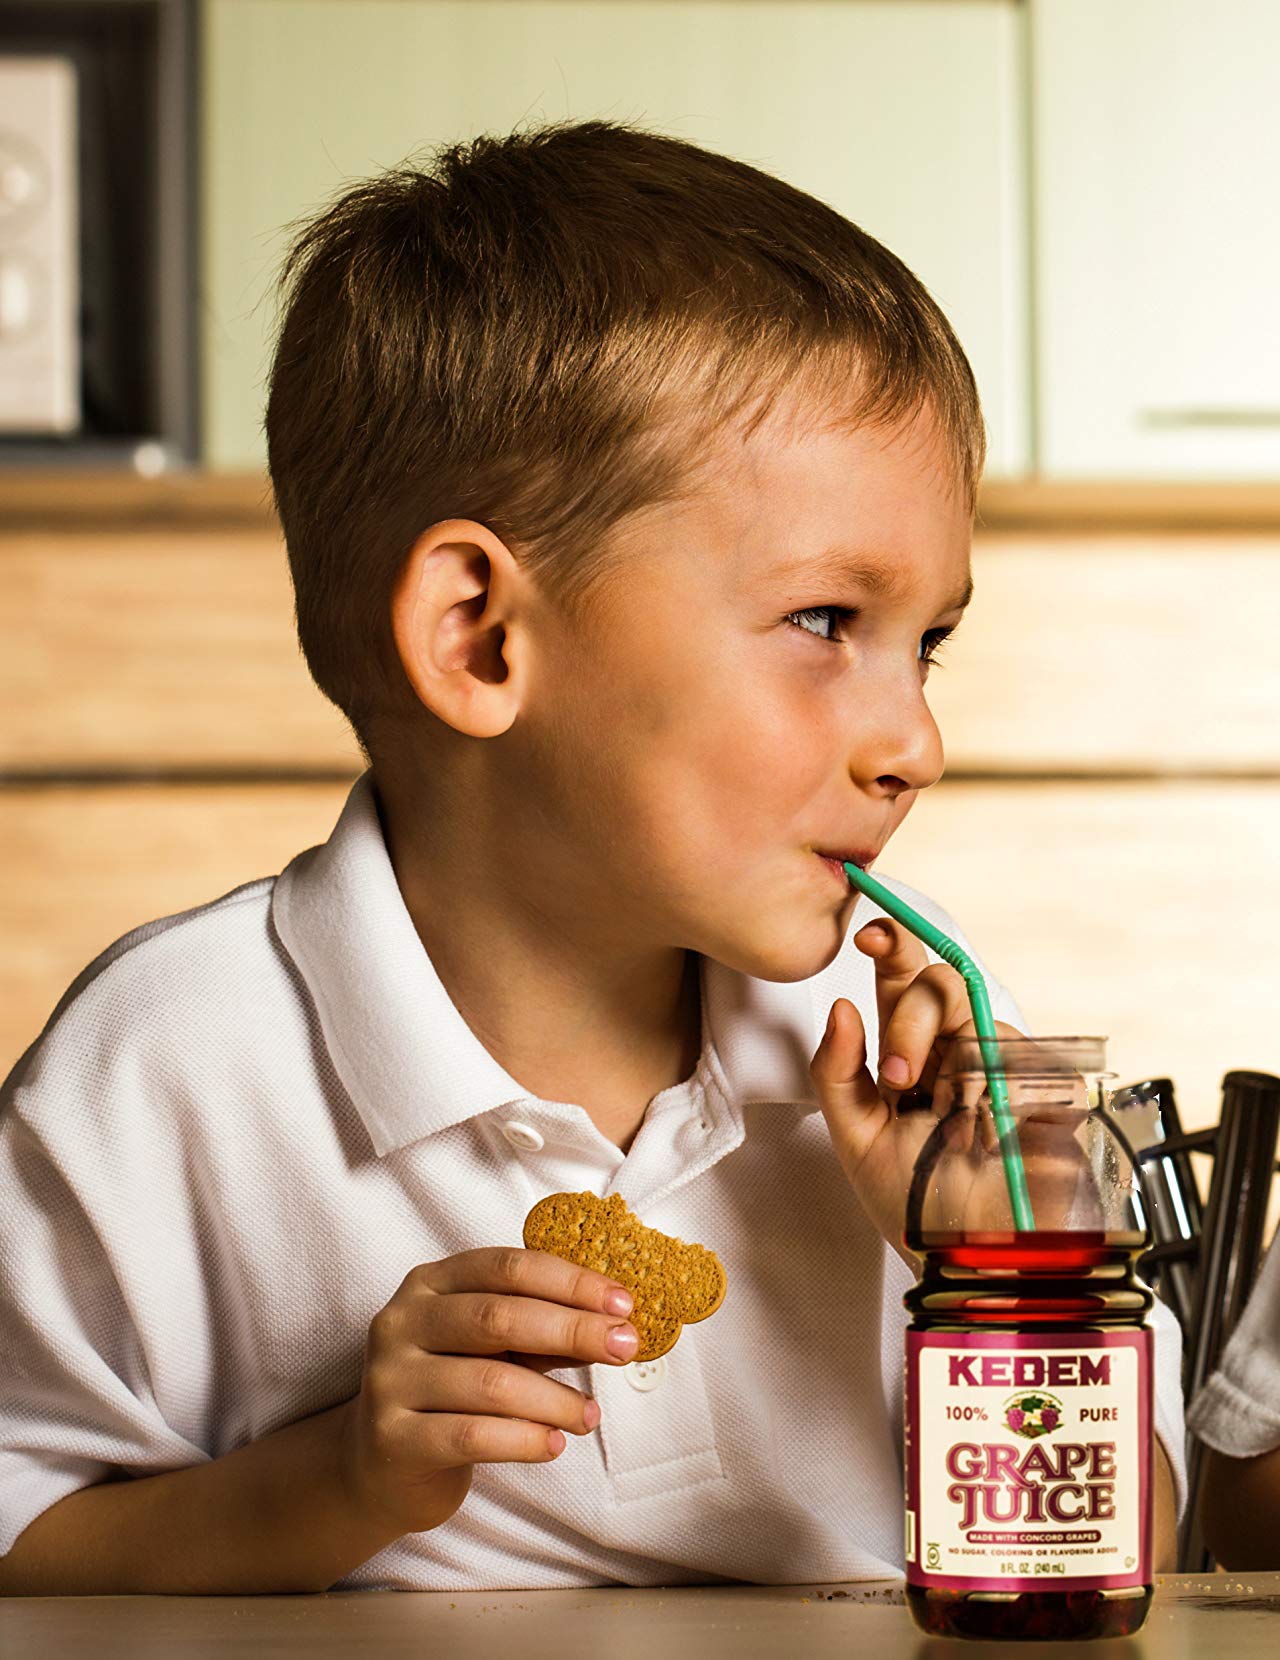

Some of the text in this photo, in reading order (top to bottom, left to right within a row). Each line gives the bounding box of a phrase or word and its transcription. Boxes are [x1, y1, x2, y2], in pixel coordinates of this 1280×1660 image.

[948, 1355, 1111, 1387] KEDEM
[945, 1405, 1119, 1422] 100% PURE
[945, 1441, 1117, 1489] GRAPE
[946, 1482, 1116, 1530] JUICE
[969, 1532, 1098, 1543] MADE WITH CONCORD GRAPES
[948, 1547, 960, 1555] NO
[991, 1549, 1033, 1557] COLORING
[1050, 1547, 1094, 1556] FLAVORING
